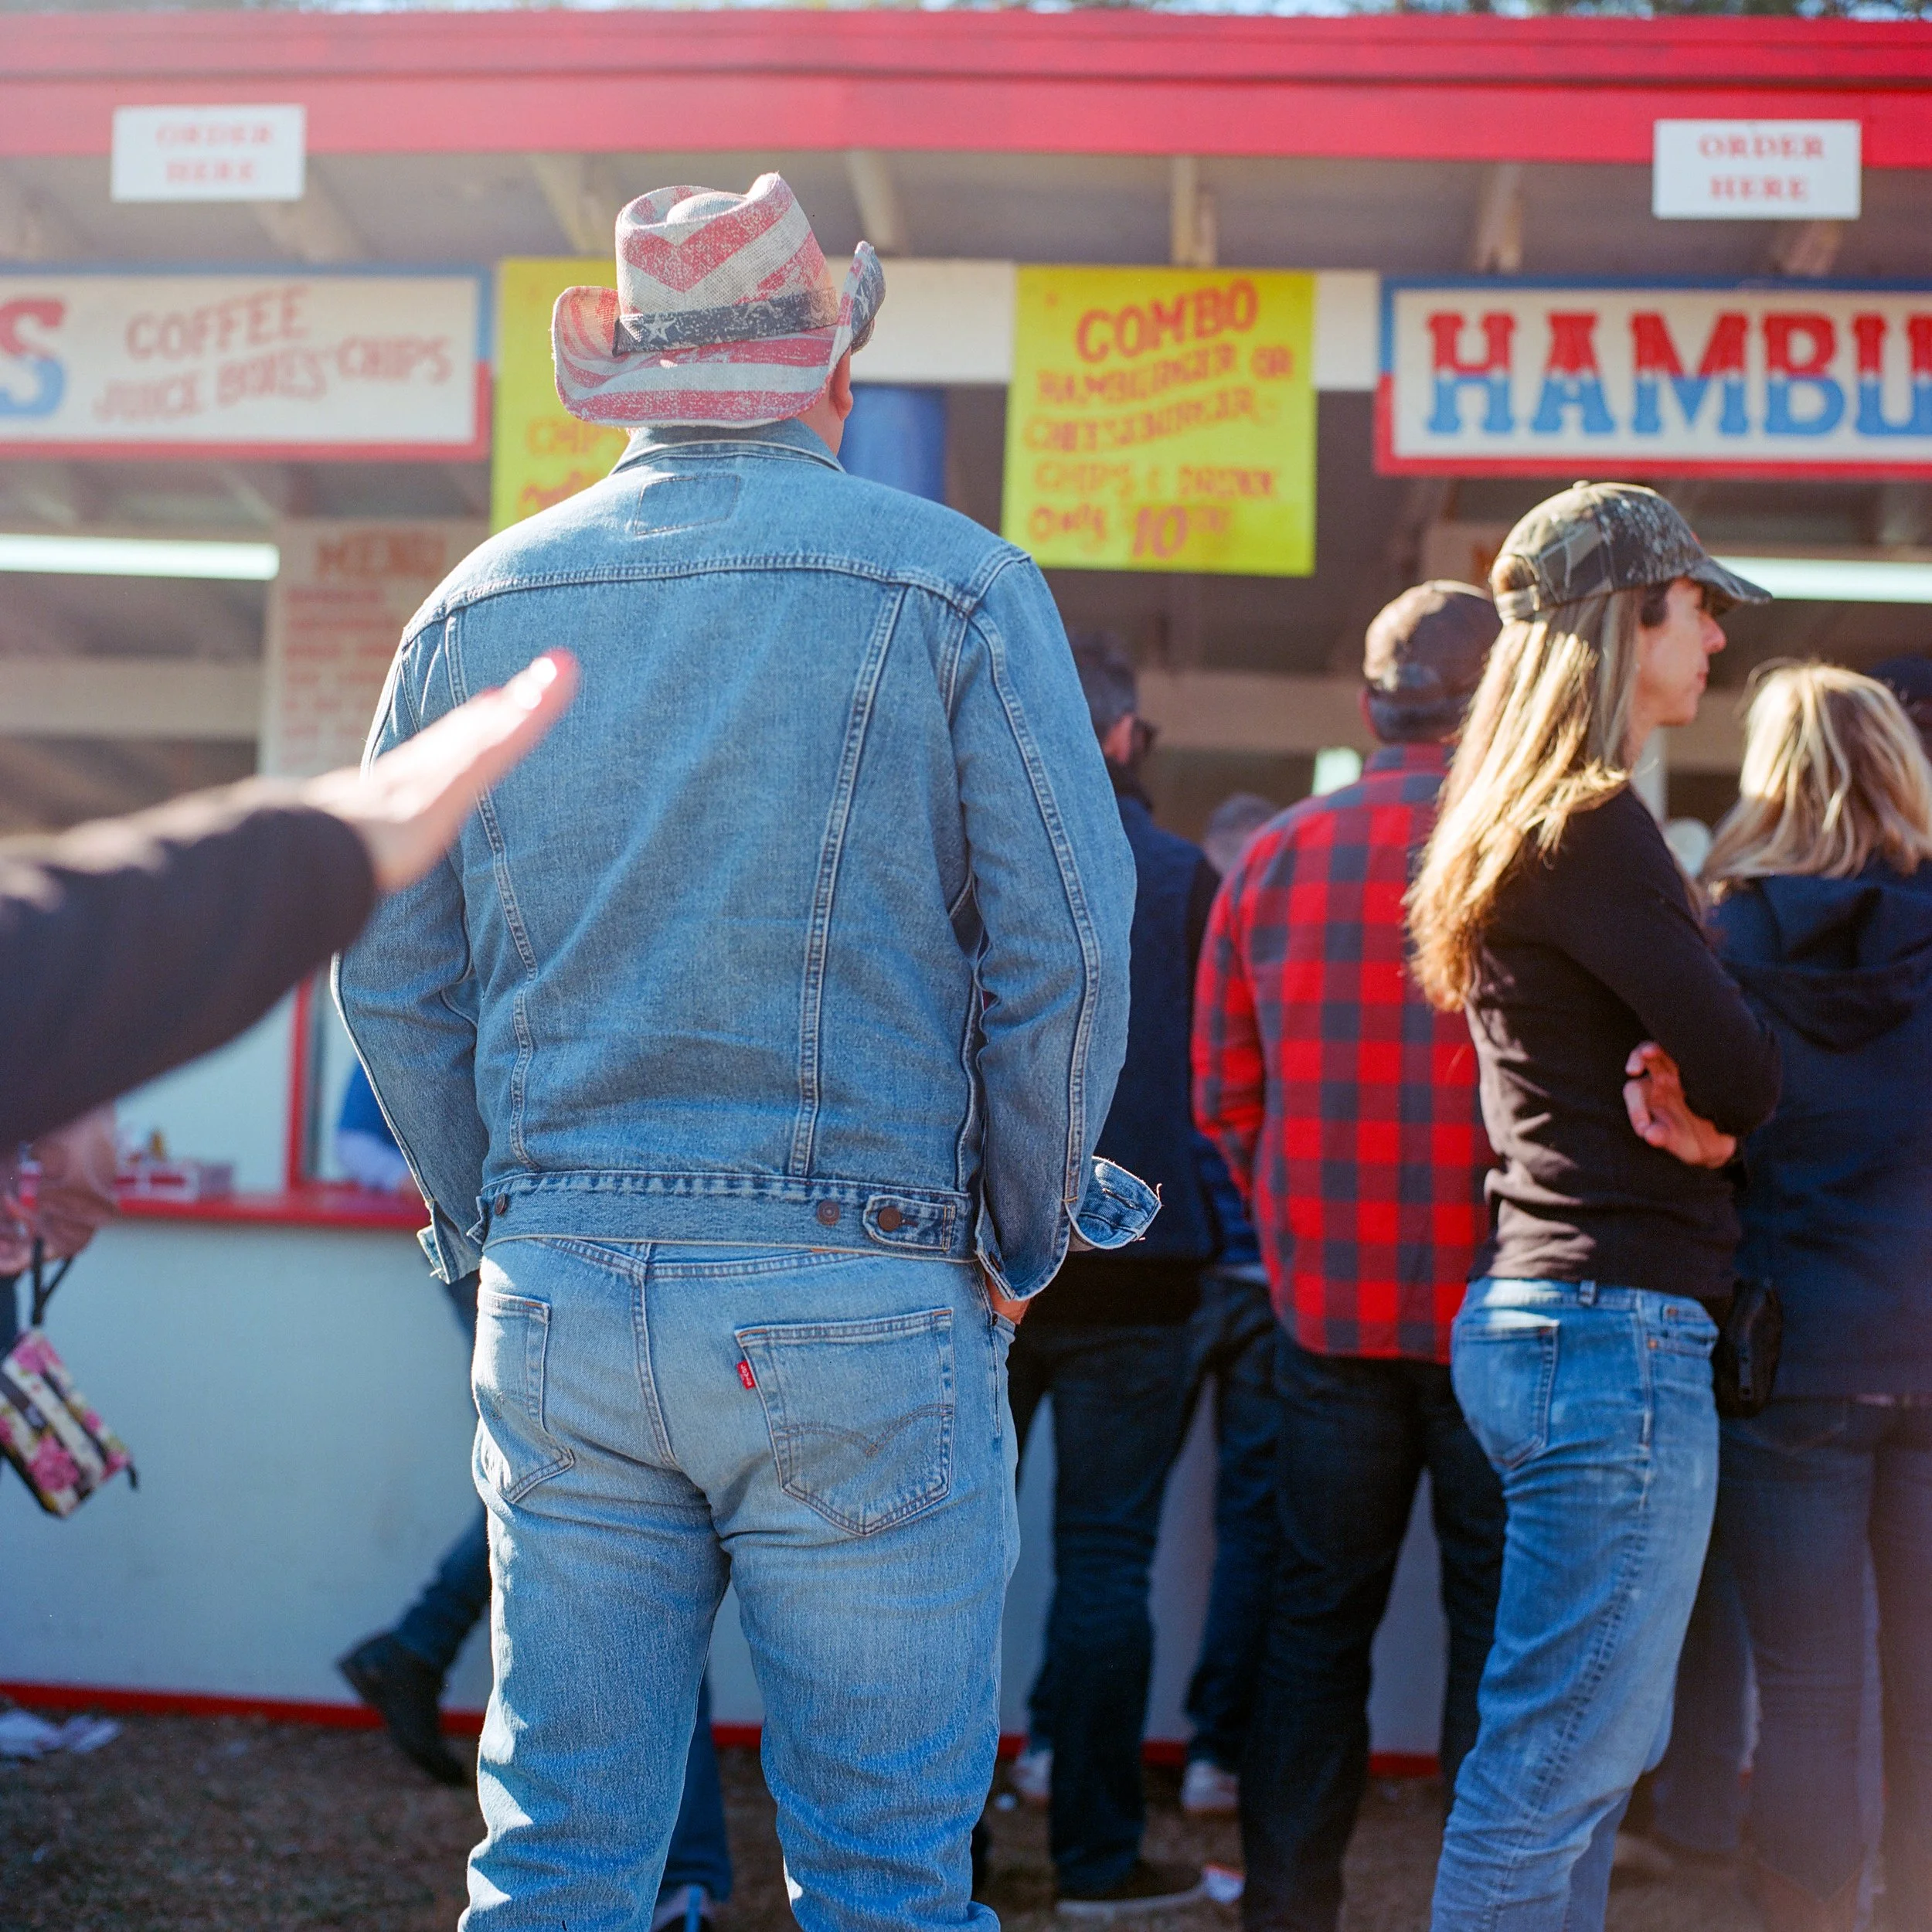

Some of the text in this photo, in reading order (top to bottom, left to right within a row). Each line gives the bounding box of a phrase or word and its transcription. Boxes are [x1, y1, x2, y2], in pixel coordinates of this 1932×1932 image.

[157, 121, 274, 148] ORDER
[1698, 133, 1825, 160] ORDER
[165, 158, 257, 185] HERE
[1709, 175, 1809, 203] HERE
[125, 285, 309, 360] COFFEE
[1075, 278, 1260, 363] COMBO
[335, 334, 454, 384] CHIPS
[1426, 311, 1932, 436] HAMBU
